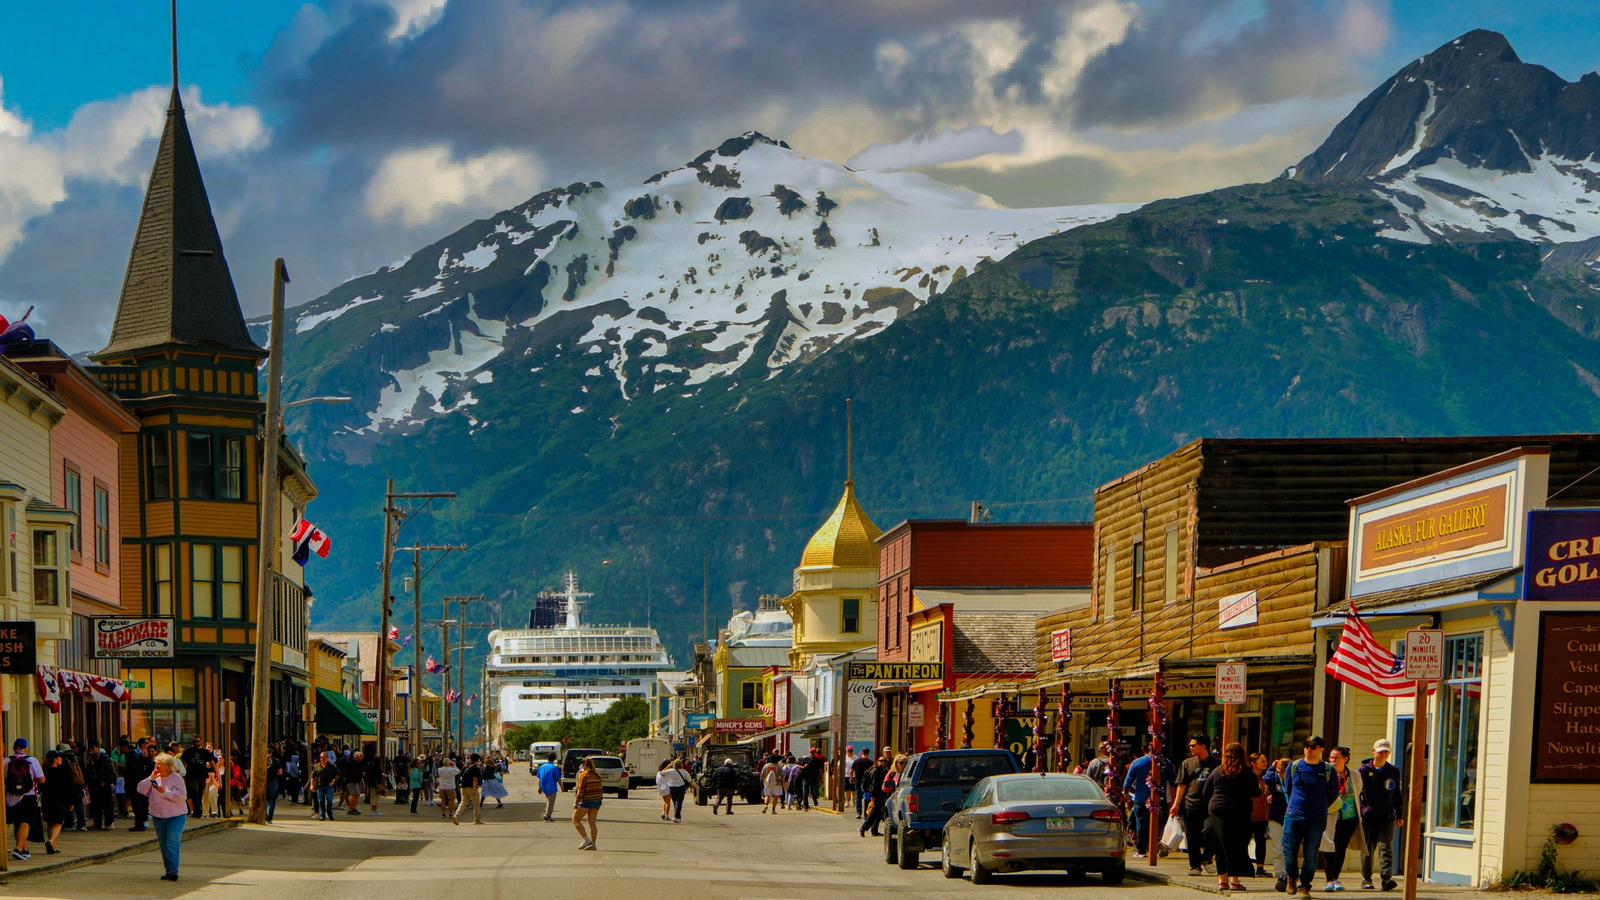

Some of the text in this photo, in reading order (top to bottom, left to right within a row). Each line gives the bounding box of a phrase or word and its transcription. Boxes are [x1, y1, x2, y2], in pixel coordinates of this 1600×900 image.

[1374, 524, 1412, 552] ALASKA
[1415, 516, 1436, 543] FUR
[1438, 503, 1488, 537] GALLERY
[1535, 562, 1600, 588] GOL
[98, 621, 168, 649] HARDWARE
[1418, 635, 1431, 644] 20
[1412, 645, 1436, 653] MINUTE
[1409, 655, 1438, 663] PARKING
[865, 664, 939, 678] PANTHEON
[1569, 661, 1599, 673] Vest
[716, 721, 743, 729] MINER'S
[744, 721, 763, 729] GEMS
[1566, 721, 1600, 734] Hats
